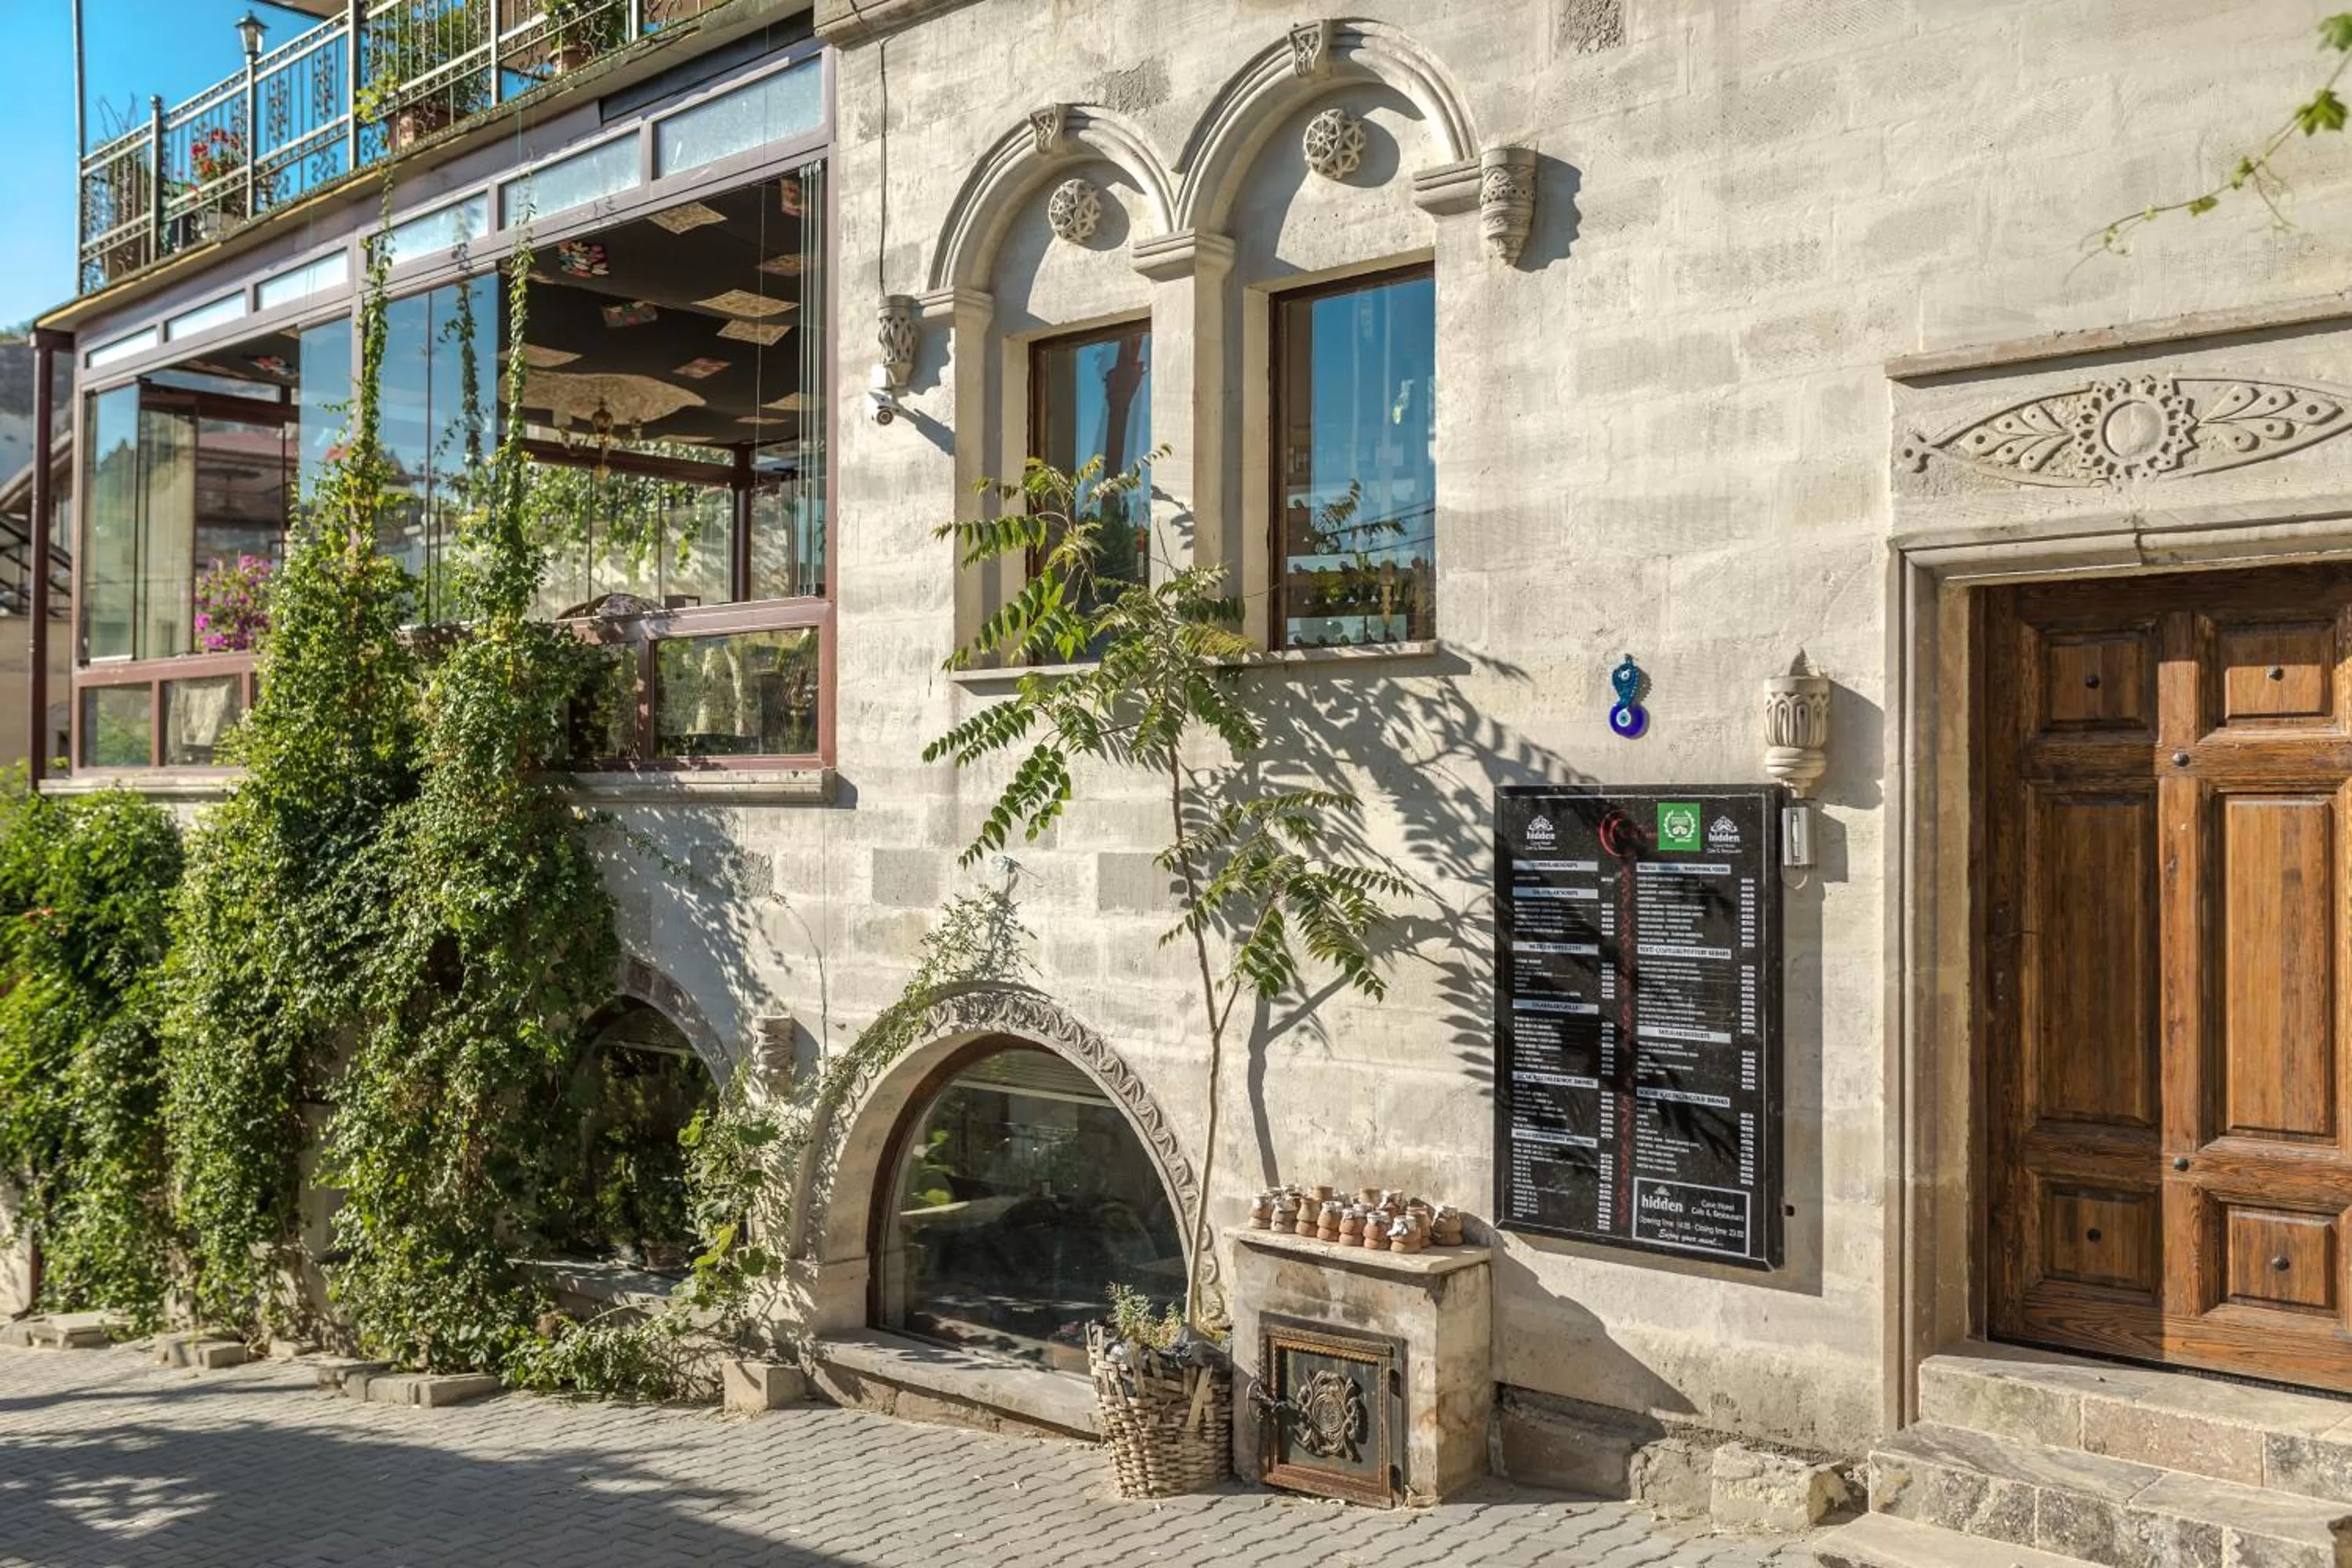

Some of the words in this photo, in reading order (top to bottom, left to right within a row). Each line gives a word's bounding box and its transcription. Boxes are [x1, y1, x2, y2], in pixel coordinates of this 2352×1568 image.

[1526, 831, 1555, 840] hidden
[1708, 833, 1740, 843] hidden
[1641, 1194, 1684, 1213] hidden
